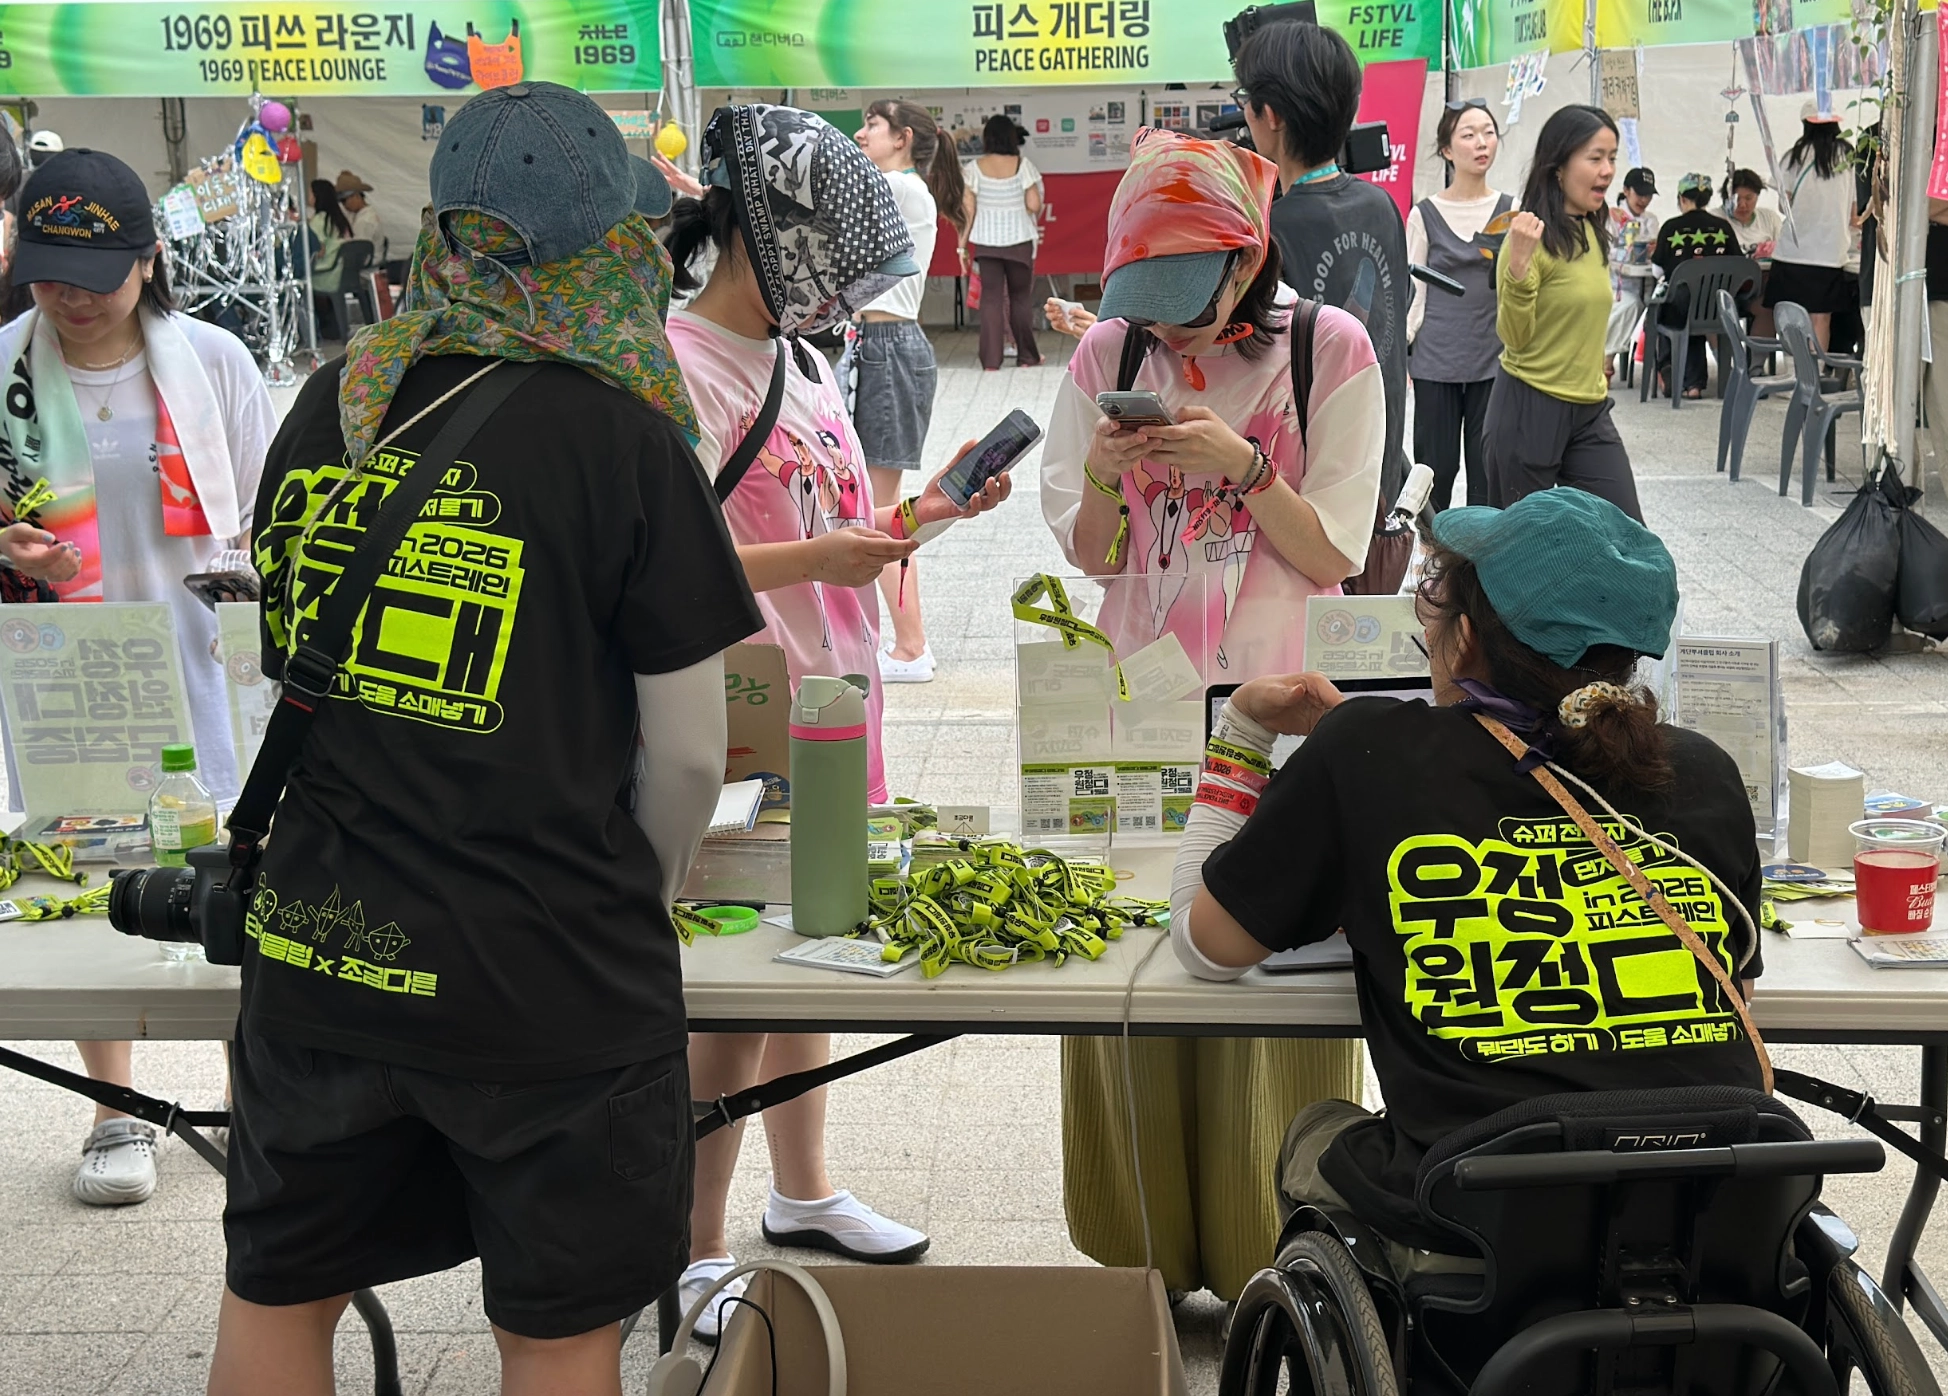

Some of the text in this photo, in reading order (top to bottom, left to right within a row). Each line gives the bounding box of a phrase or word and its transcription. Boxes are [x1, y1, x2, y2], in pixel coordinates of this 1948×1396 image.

[973, 1, 1149, 41] 피스 개더링
[1349, 4, 1416, 25] FSTVL
[161, 13, 415, 51] 1969 피쓰 라운지
[750, 33, 804, 47] 핸디버스
[1359, 29, 1403, 48] LIFE
[574, 45, 636, 65] 1969
[976, 45, 1149, 72] PEACE GATHERING
[199, 58, 387, 81] 1969 PEACE LOUNGE
[741, 106, 750, 132] THAT
[743, 136, 754, 153] DAY
[749, 166, 761, 197] WHAT
[1372, 165, 1399, 183] LIFE
[27, 196, 53, 222] MASAN
[84, 201, 120, 232] JINHAE
[754, 200, 771, 240] SWAMP
[42, 224, 92, 239] CHANGWON
[1313, 231, 1392, 305] GOOD FOR HEALTH
[418, 498, 484, 519] 저물기
[419, 533, 511, 571] 2026
[387, 556, 511, 599] 피스트레인
[359, 680, 488, 726] 도움 소매넣기
[1213, 761, 1232, 776] 2026
[1513, 824, 1557, 843] 슈퍼
[1398, 845, 1573, 938] 우정
[1582, 890, 1617, 909] in
[1411, 936, 1728, 1028] 원정대
[1476, 1030, 1550, 1056] 뭐라도
[1552, 1029, 1599, 1054] 하기
[1621, 1026, 1668, 1049] 도움
